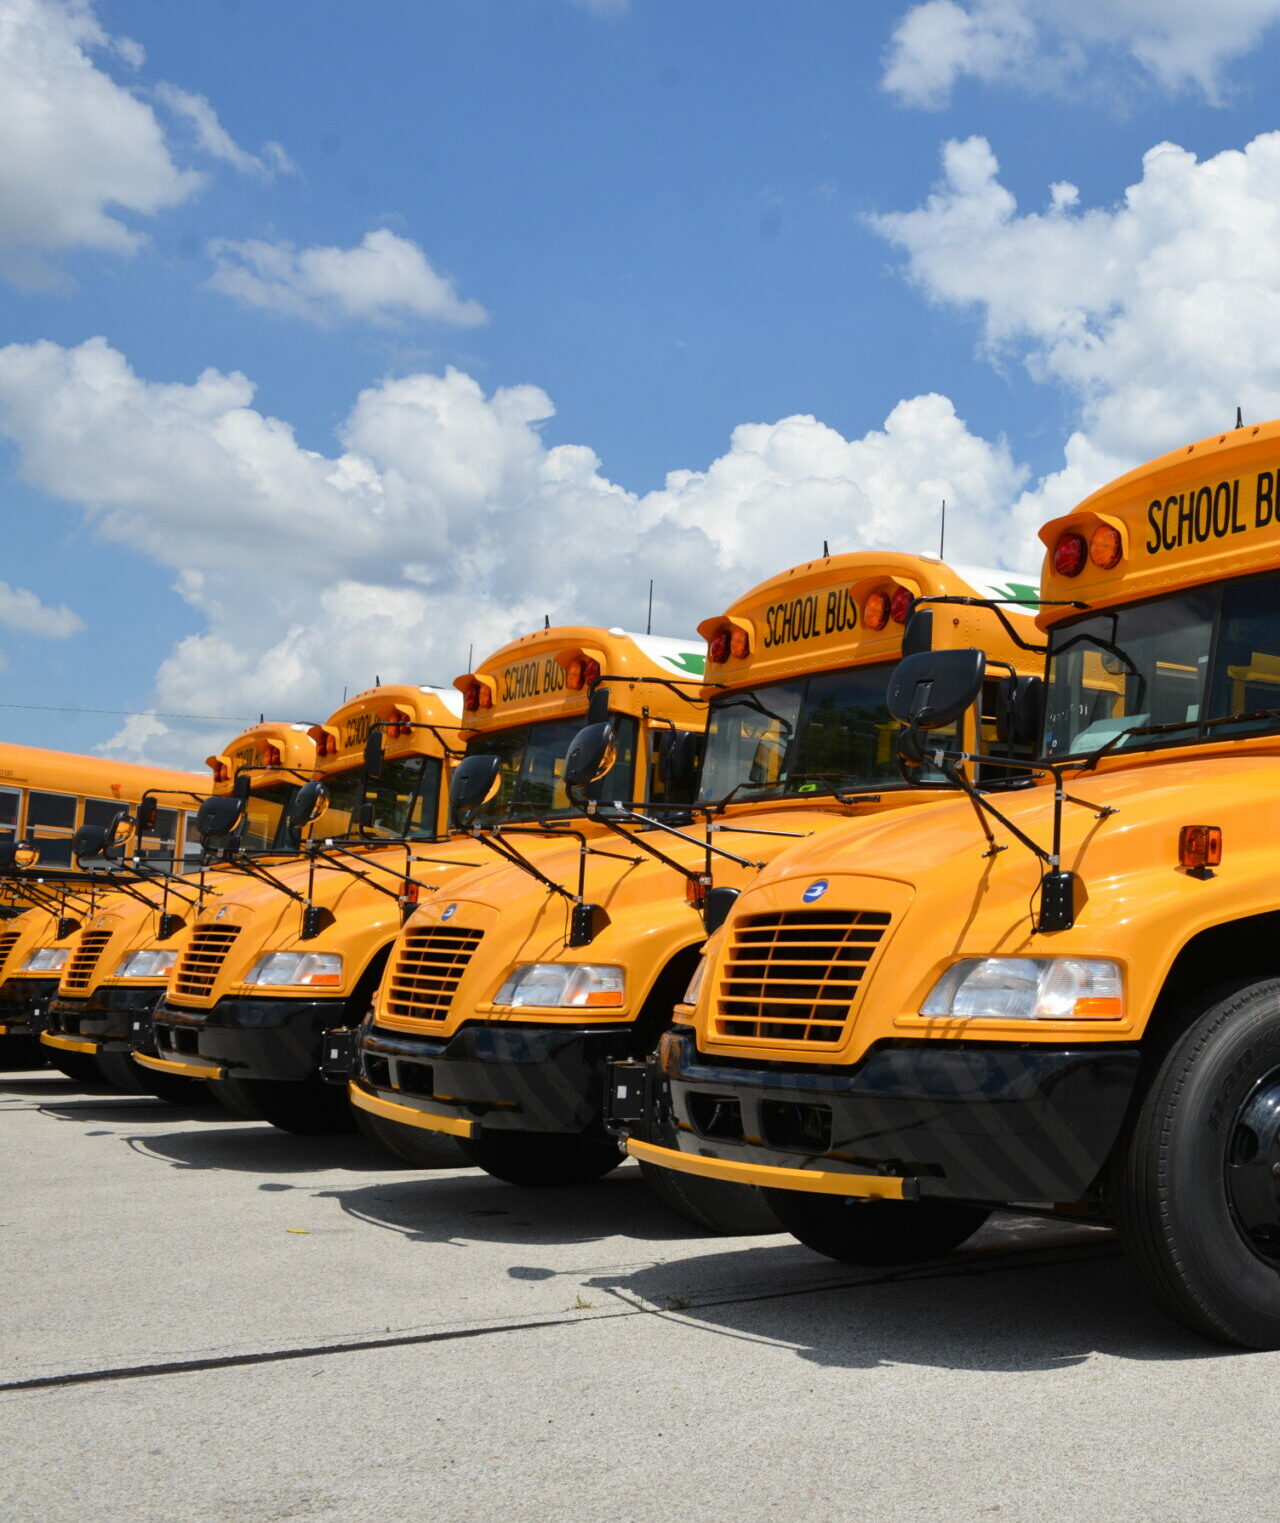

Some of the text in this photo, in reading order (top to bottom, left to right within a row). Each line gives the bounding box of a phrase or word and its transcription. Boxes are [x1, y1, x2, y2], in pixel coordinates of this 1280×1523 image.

[1146, 479, 1246, 554] SCHOOL
[764, 588, 857, 648] SCHOOL BUS
[502, 661, 540, 702] SCHOOL
